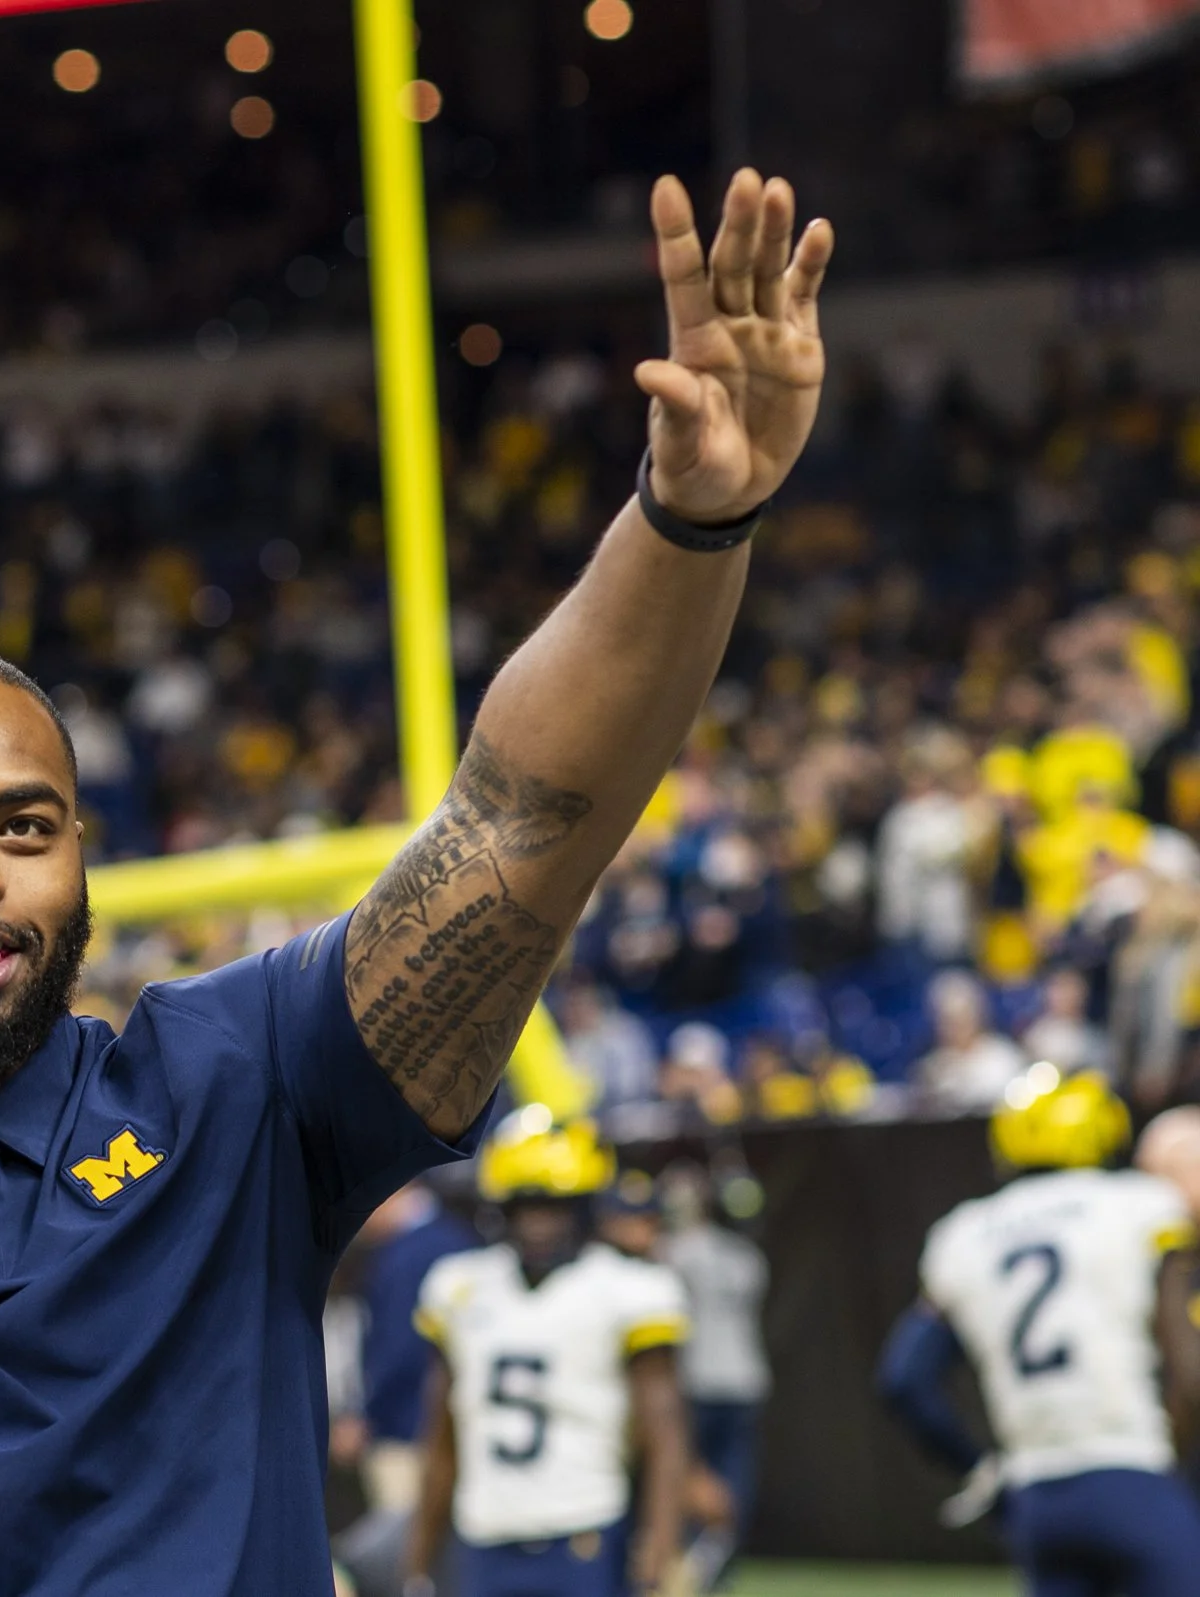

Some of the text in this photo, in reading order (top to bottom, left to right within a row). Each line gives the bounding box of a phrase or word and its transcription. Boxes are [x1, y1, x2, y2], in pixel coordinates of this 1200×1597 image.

[404, 892, 497, 972] between
[421, 955, 460, 998] and
[455, 924, 498, 957] the
[404, 945, 533, 1078] determination
[70, 1129, 159, 1202] M
[1000, 1244, 1072, 1377] 2
[491, 1355, 548, 1466] 5
